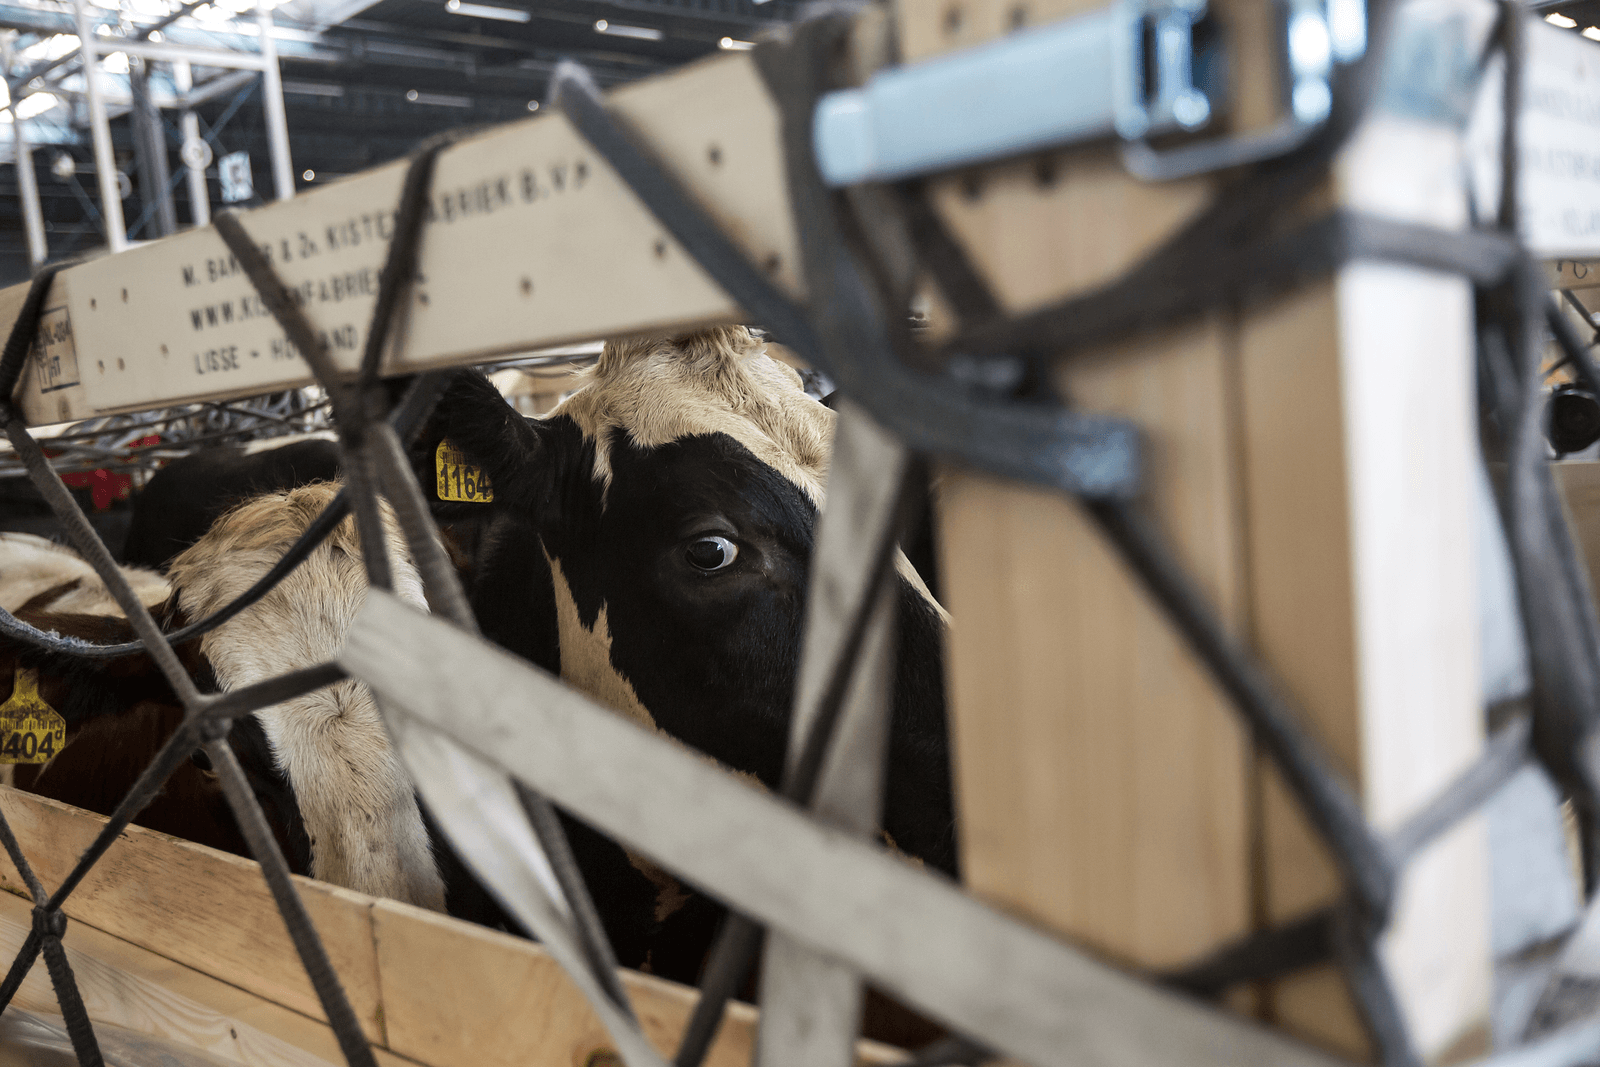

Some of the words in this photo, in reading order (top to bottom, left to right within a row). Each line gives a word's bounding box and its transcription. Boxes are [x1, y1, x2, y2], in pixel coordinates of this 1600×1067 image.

[195, 345, 240, 374] LISSE
[440, 463, 492, 500] 1164
[0, 731, 55, 759] 404
